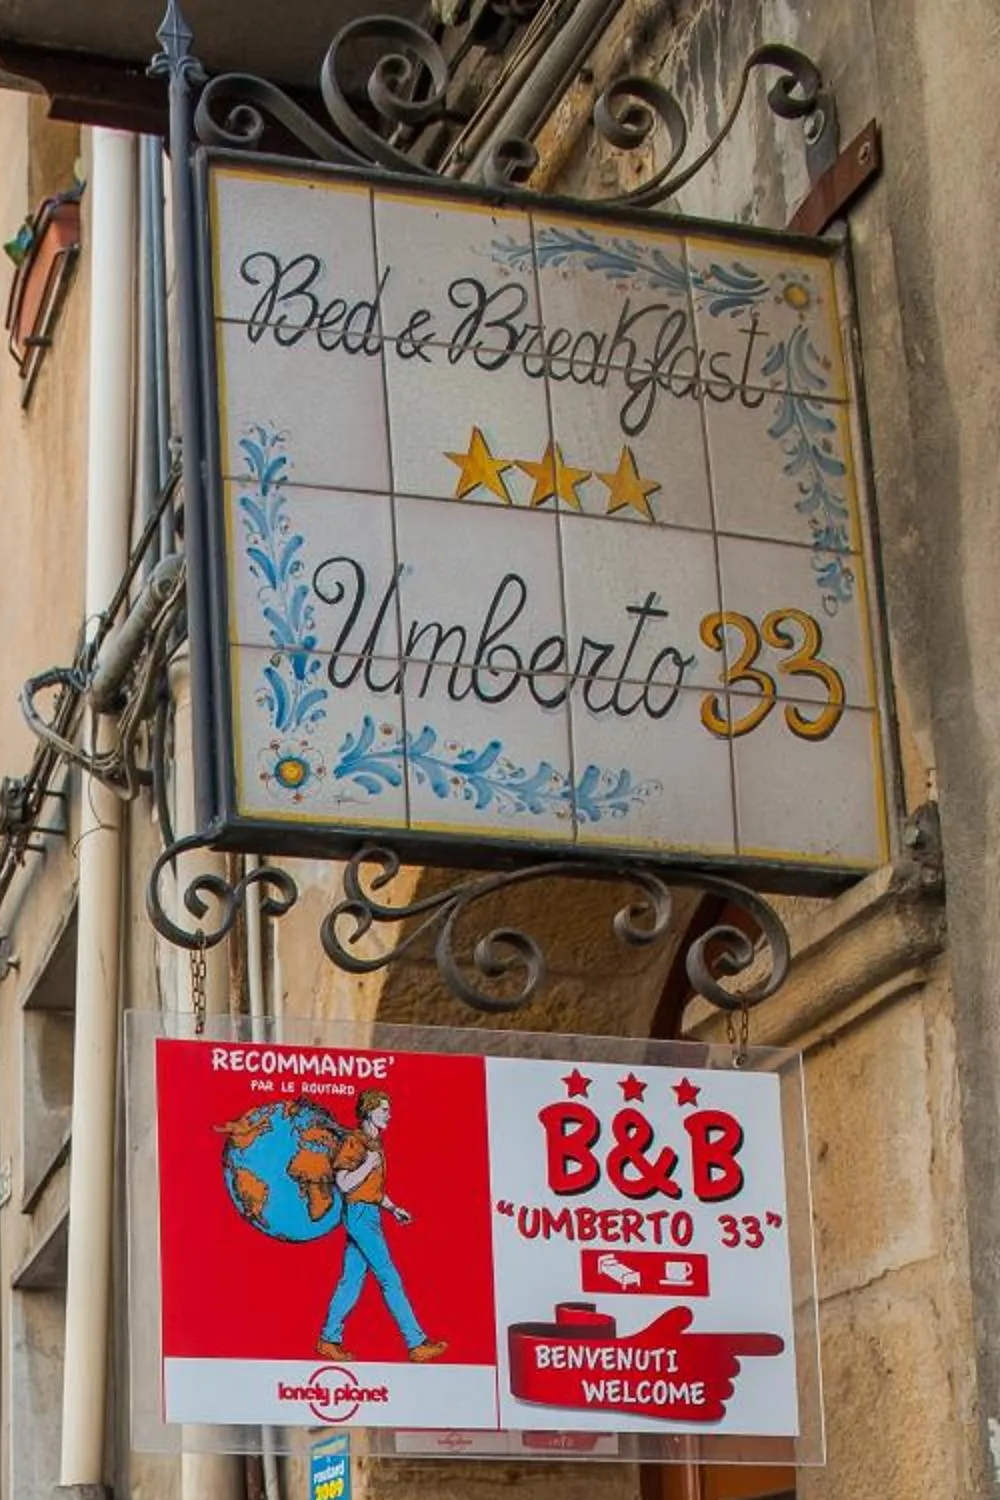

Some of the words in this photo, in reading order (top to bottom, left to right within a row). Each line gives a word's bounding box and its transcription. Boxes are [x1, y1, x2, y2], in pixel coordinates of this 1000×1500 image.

[239, 252, 390, 356] Bed
[394, 308, 438, 362] &
[447, 277, 768, 437] Breakfast
[311, 556, 694, 720] Umberto
[699, 607, 846, 740] 33
[251, 1079, 274, 1092] PAR
[281, 1081, 295, 1093] LE
[302, 1082, 356, 1096] ROUTARD
[538, 1101, 745, 1202] B&B
[535, 1344, 679, 1373] BENVENUTI
[278, 1381, 330, 1407] lonely
[333, 1383, 389, 1406] planet
[581, 1379, 706, 1405] WELCOME
